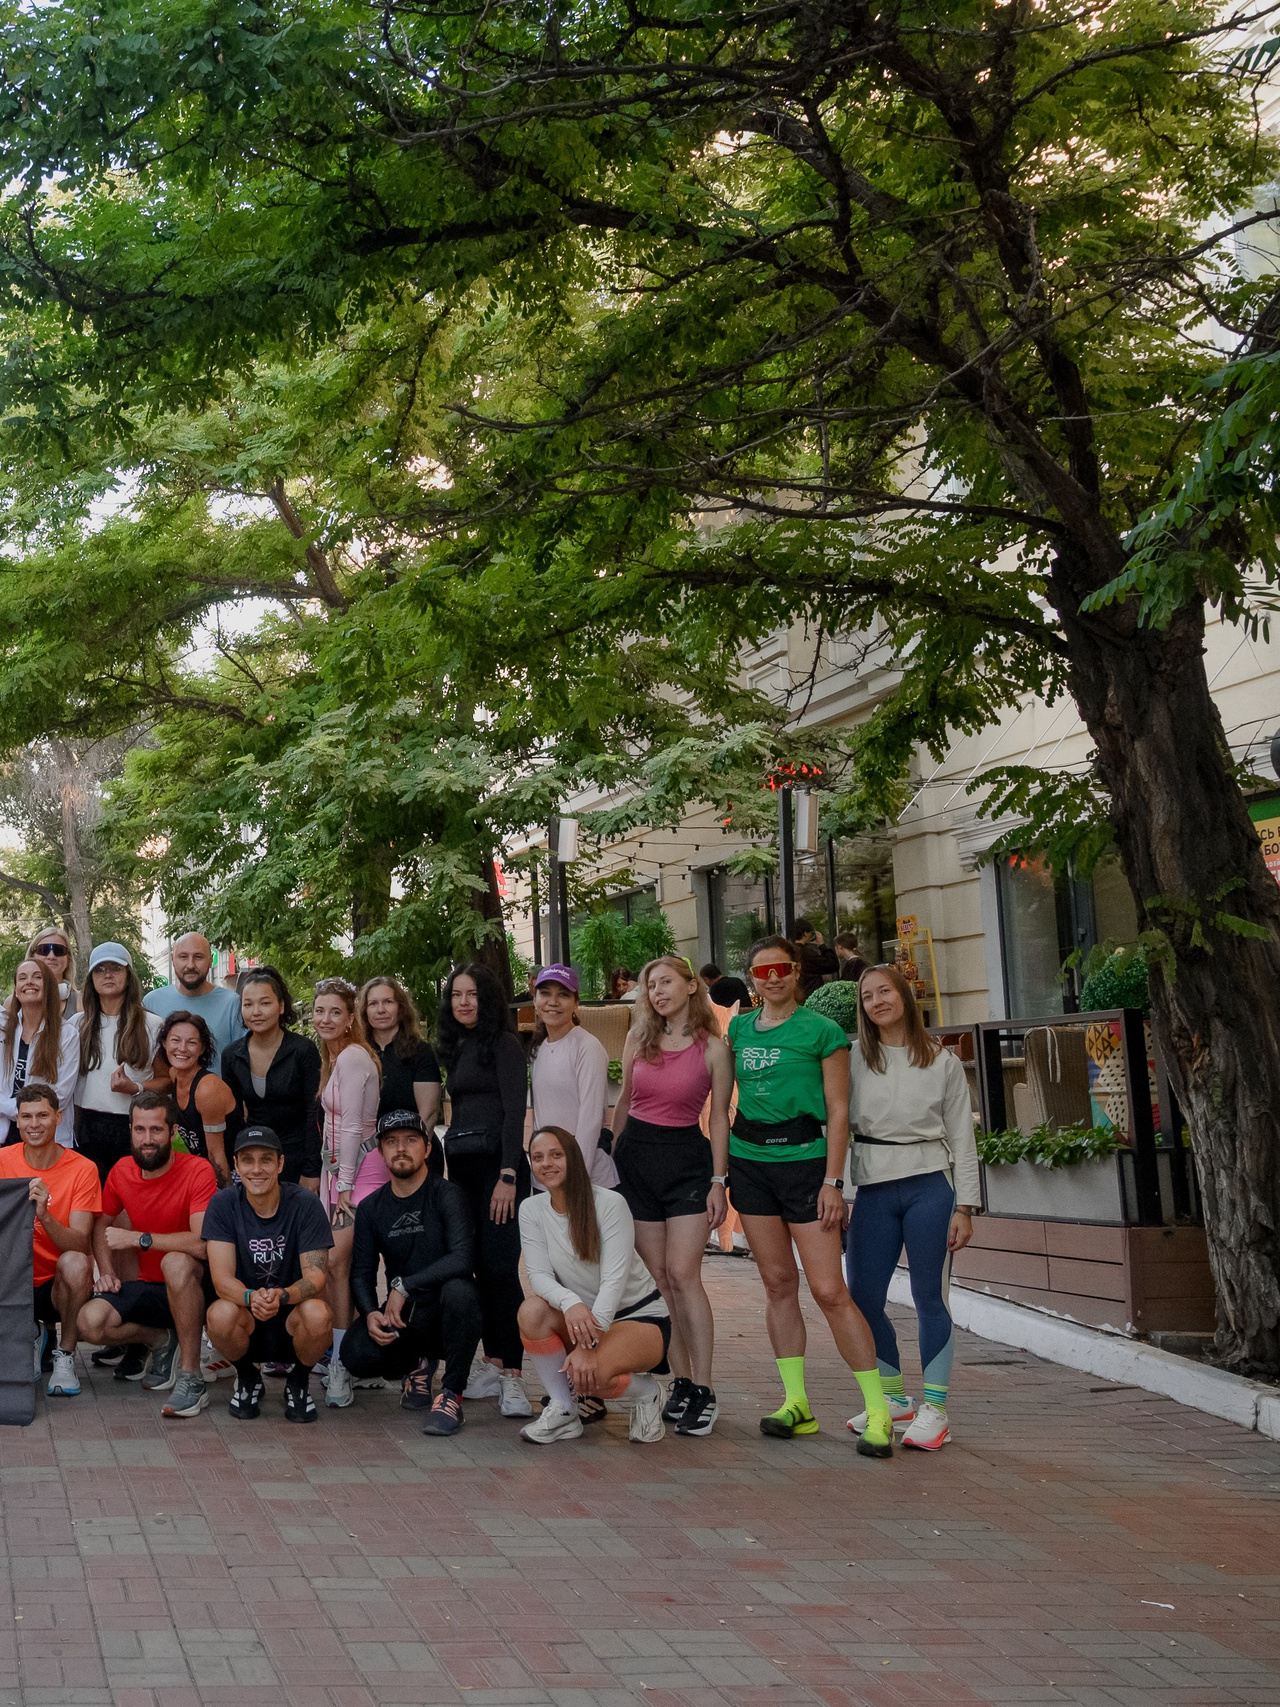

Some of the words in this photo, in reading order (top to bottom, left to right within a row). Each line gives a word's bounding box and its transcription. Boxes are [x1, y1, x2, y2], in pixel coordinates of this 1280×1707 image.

[1264, 842, 1280, 856] БО
[743, 1059, 776, 1070] RUN
[253, 1247, 285, 1264] RUN
